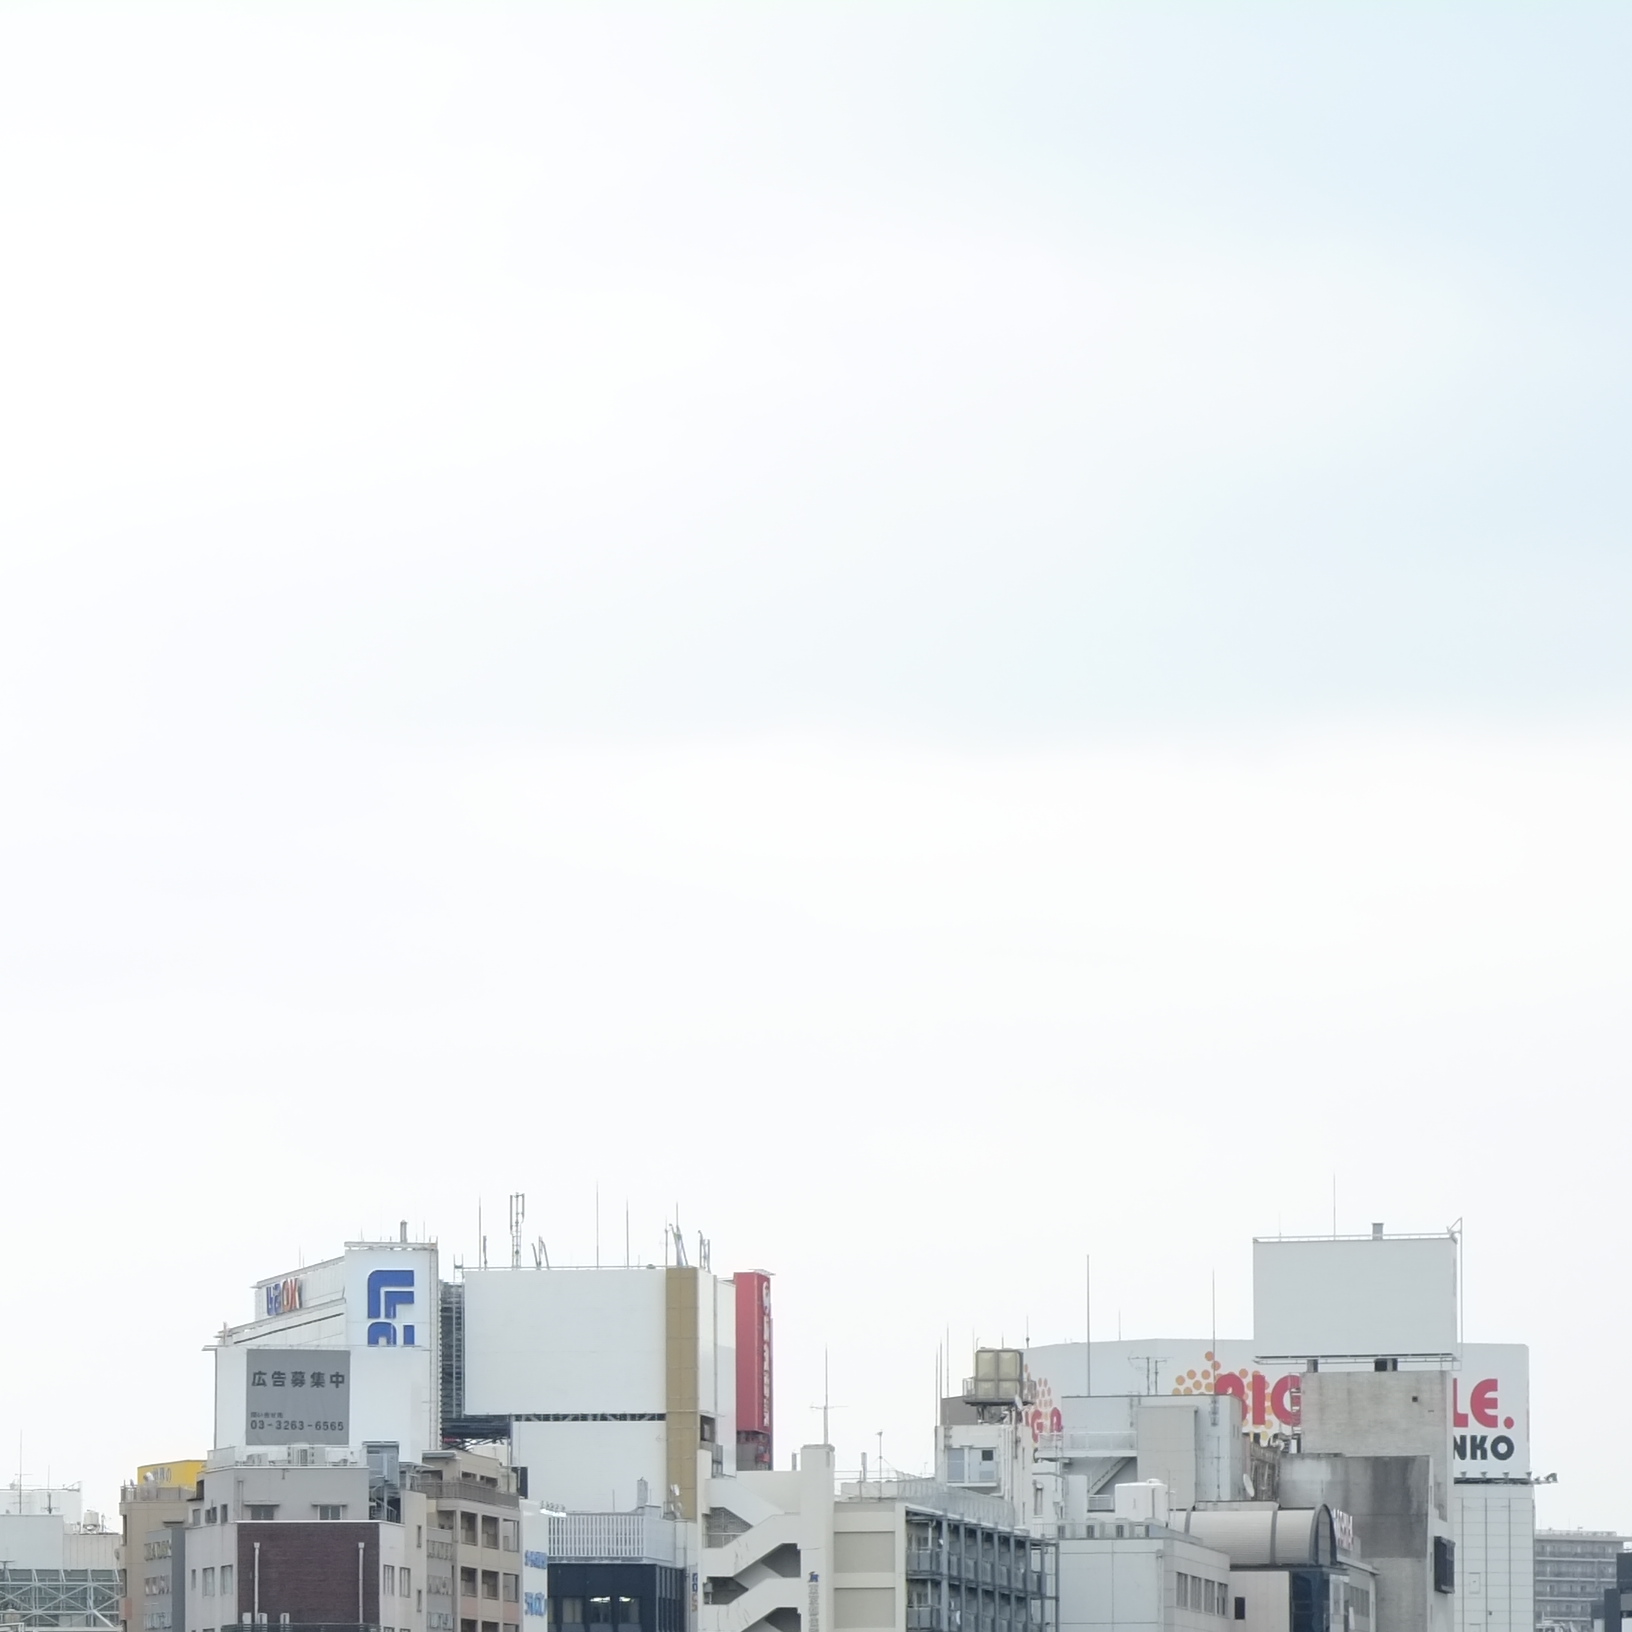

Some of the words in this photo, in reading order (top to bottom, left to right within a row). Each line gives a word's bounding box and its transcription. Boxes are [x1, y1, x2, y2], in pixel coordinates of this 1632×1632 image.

[251, 1370, 345, 1388] 広告募集中
[250, 1419, 344, 1431] 03-3263-6565
